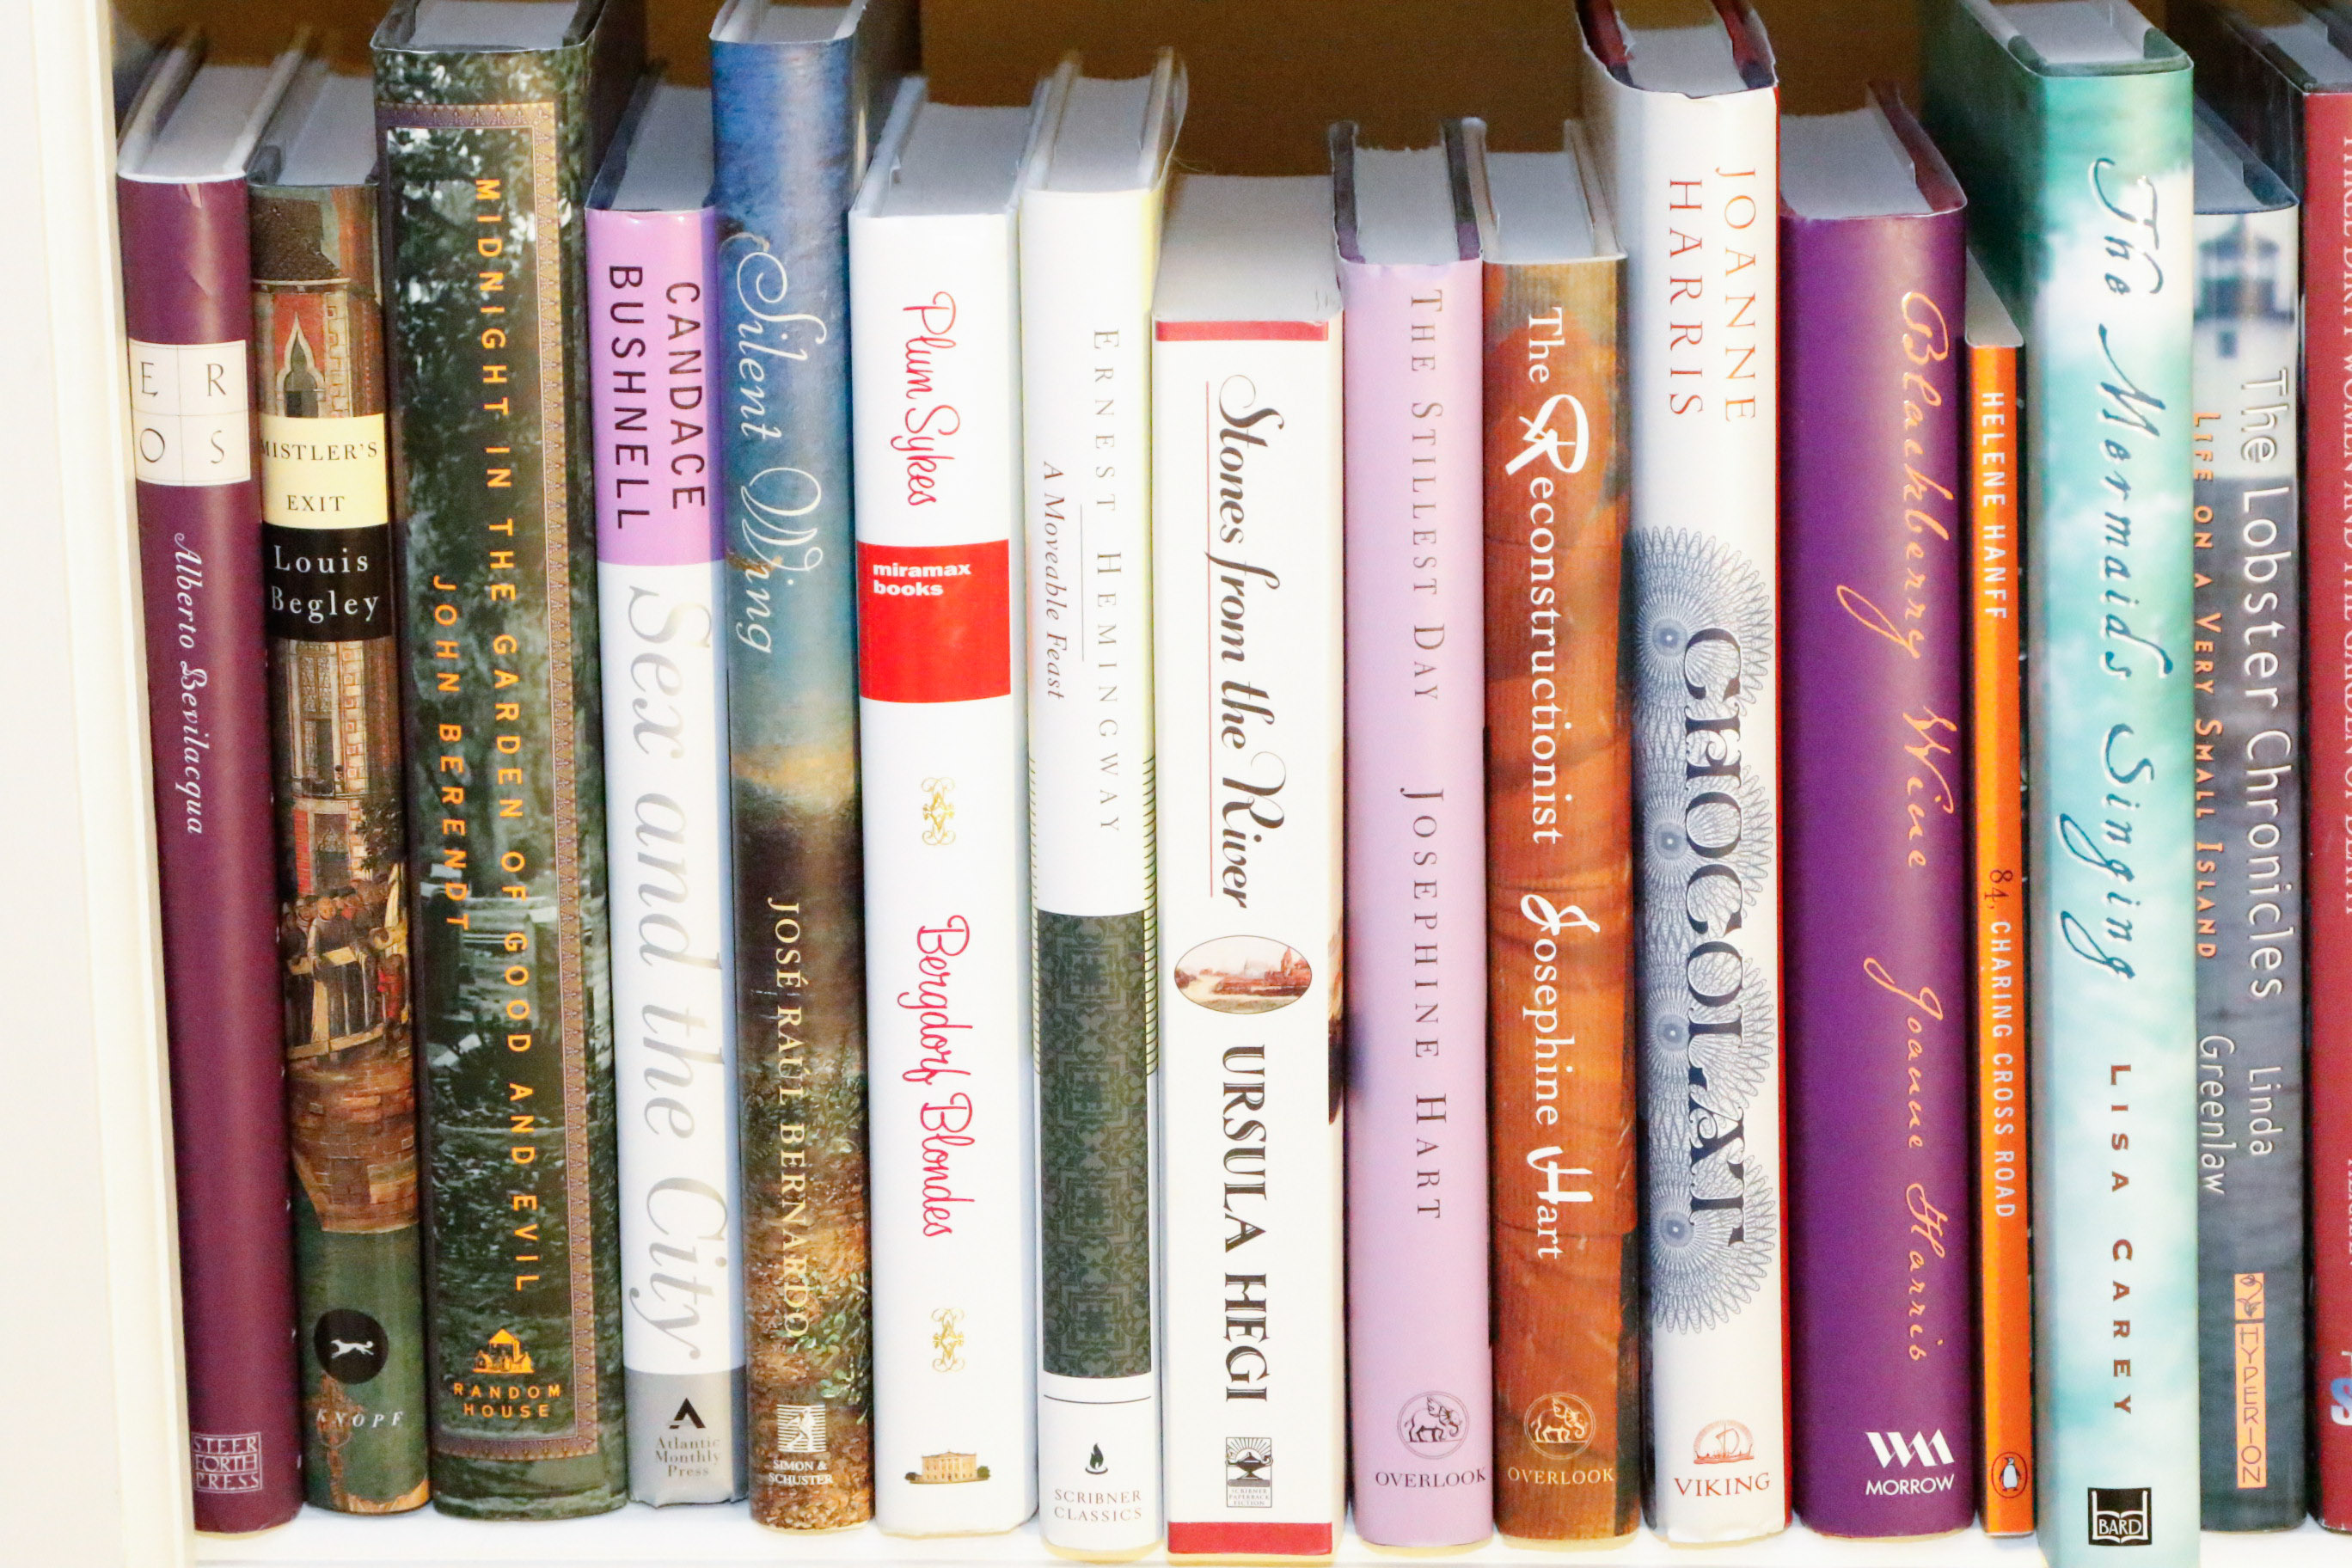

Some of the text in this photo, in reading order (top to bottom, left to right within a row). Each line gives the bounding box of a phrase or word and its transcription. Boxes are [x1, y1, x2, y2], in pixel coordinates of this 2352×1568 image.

[737, 251, 827, 438] Silent
[1669, 179, 1703, 415] HARRIS
[1715, 168, 1755, 422] JOANNE
[609, 266, 650, 530] BUSHNELL
[665, 281, 706, 510] CANDACE
[891, 291, 960, 506] Plum Sykes
[2194, 412, 2220, 481] LIFE
[286, 494, 345, 513] EXIT
[1411, 289, 1445, 701] THE STILLEST DAY
[1982, 392, 2006, 618] HELENE HANFF
[2194, 505, 2214, 548] ON
[271, 585, 380, 624] Begley
[274, 544, 371, 572] Louis
[873, 561, 971, 578] miramax
[873, 579, 943, 596] books
[1044, 462, 1068, 700] A Moveable Feast
[1093, 329, 1122, 831] ERNEST HEMINGWAY
[1505, 307, 1589, 844] The Reconstructionist
[1836, 291, 1957, 867] Blackberry Wine
[2056, 157, 2173, 980] The Mermaids Singing
[175, 532, 208, 836] Alberto Bevilacqua
[1204, 374, 1287, 910] Stones from the River
[2195, 612, 2222, 695] VERY
[2240, 367, 2294, 998] The Lobster Chronicles
[433, 576, 469, 929] JOHN BERENDT
[476, 178, 540, 1291] MIDNIGHT IN THE GARDEN OF GOOD AND EVIL
[2195, 719, 2223, 818] SMALL
[1684, 628, 1745, 1247] CHOCOLAT
[2196, 842, 2223, 959] ISLAND
[628, 585, 727, 1359] Sex and the City
[1400, 787, 1447, 1220] JOSEPHINE HART
[1990, 921, 2012, 1038] CHARING
[768, 897, 811, 1338] JOSÉ RAÚL BERNARDO
[897, 914, 976, 1238] Bergdorf Blondes
[1521, 894, 1601, 1259] Josephine Hart
[1993, 1053, 2013, 1135] CROSS
[2199, 1035, 2237, 1195] Greenlaw
[2248, 1065, 2283, 1156] Linda
[1864, 957, 1948, 1362] Joanne Harris
[1994, 1150, 2015, 1217] ROAD
[1222, 1044, 1271, 1402] URSULA HEGI
[2110, 1064, 2133, 1415] LISA CAREY
[316, 1409, 403, 1428] KNOPF
[454, 1382, 560, 1400] RANDOM
[463, 1403, 549, 1418] HOUSE
[656, 1436, 720, 1450] Atlantic
[2239, 1326, 2262, 1483] HYPERION
[196, 1473, 259, 1490] PRESS
[655, 1449, 720, 1466] Monthly
[668, 1464, 709, 1478] Press
[769, 1473, 833, 1485] SCHUSTER
[772, 1459, 827, 1472] SIMON &
[1053, 1506, 1142, 1522] CLASSICS
[1054, 1488, 1142, 1504] SCRIBNER
[1375, 1468, 1486, 1489] OVERLOOK
[1507, 1467, 1614, 1485] OVERLOOK
[1675, 1472, 1770, 1497] VIKING
[1865, 1475, 1954, 1495] MORROW
[2099, 1518, 2142, 1536] BARD
